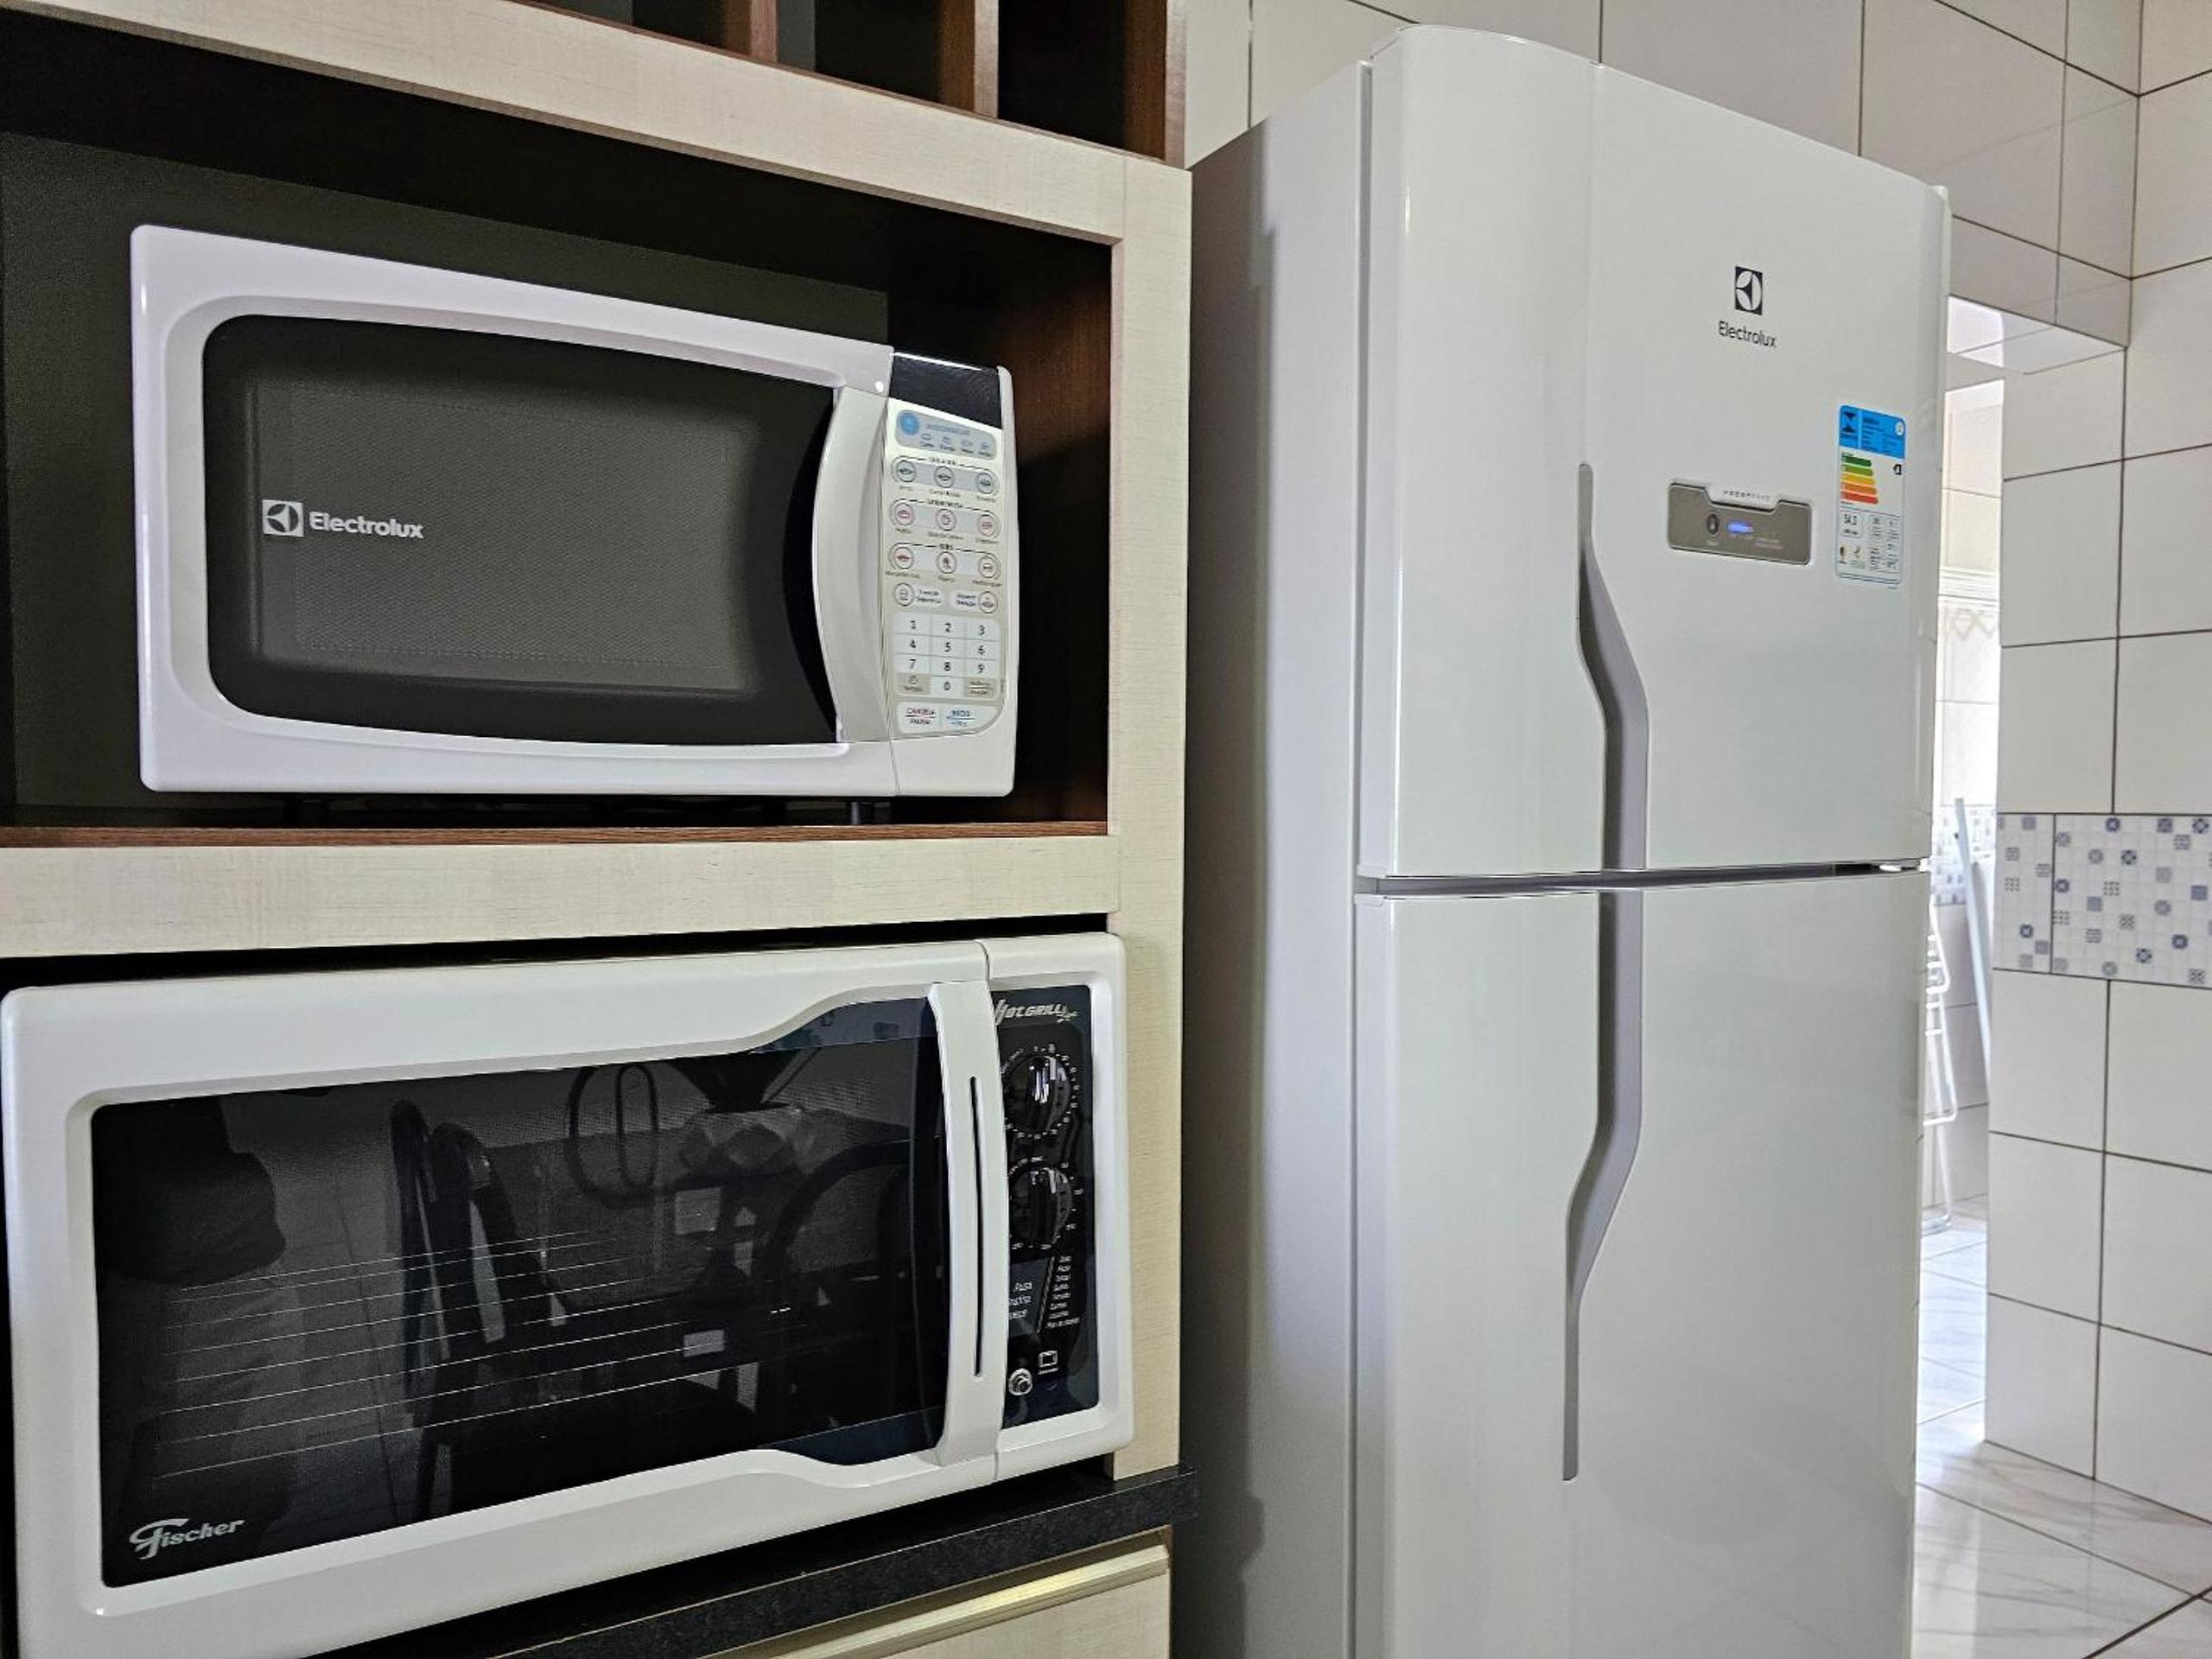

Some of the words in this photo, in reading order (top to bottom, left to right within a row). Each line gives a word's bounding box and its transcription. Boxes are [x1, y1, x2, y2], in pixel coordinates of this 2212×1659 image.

[1719, 320, 1777, 348] Electrolux
[309, 511, 424, 539] Electrolux
[910, 620, 916, 630] 1
[944, 622, 951, 632] 2
[979, 625, 985, 636] 3
[909, 639, 916, 648] 4
[944, 641, 951, 652] 5
[978, 645, 985, 655] 6
[909, 658, 916, 670] 7
[944, 661, 951, 671] 8
[977, 663, 984, 673] 9
[944, 681, 950, 691] 0
[130, 1518, 245, 1560] Fischer
